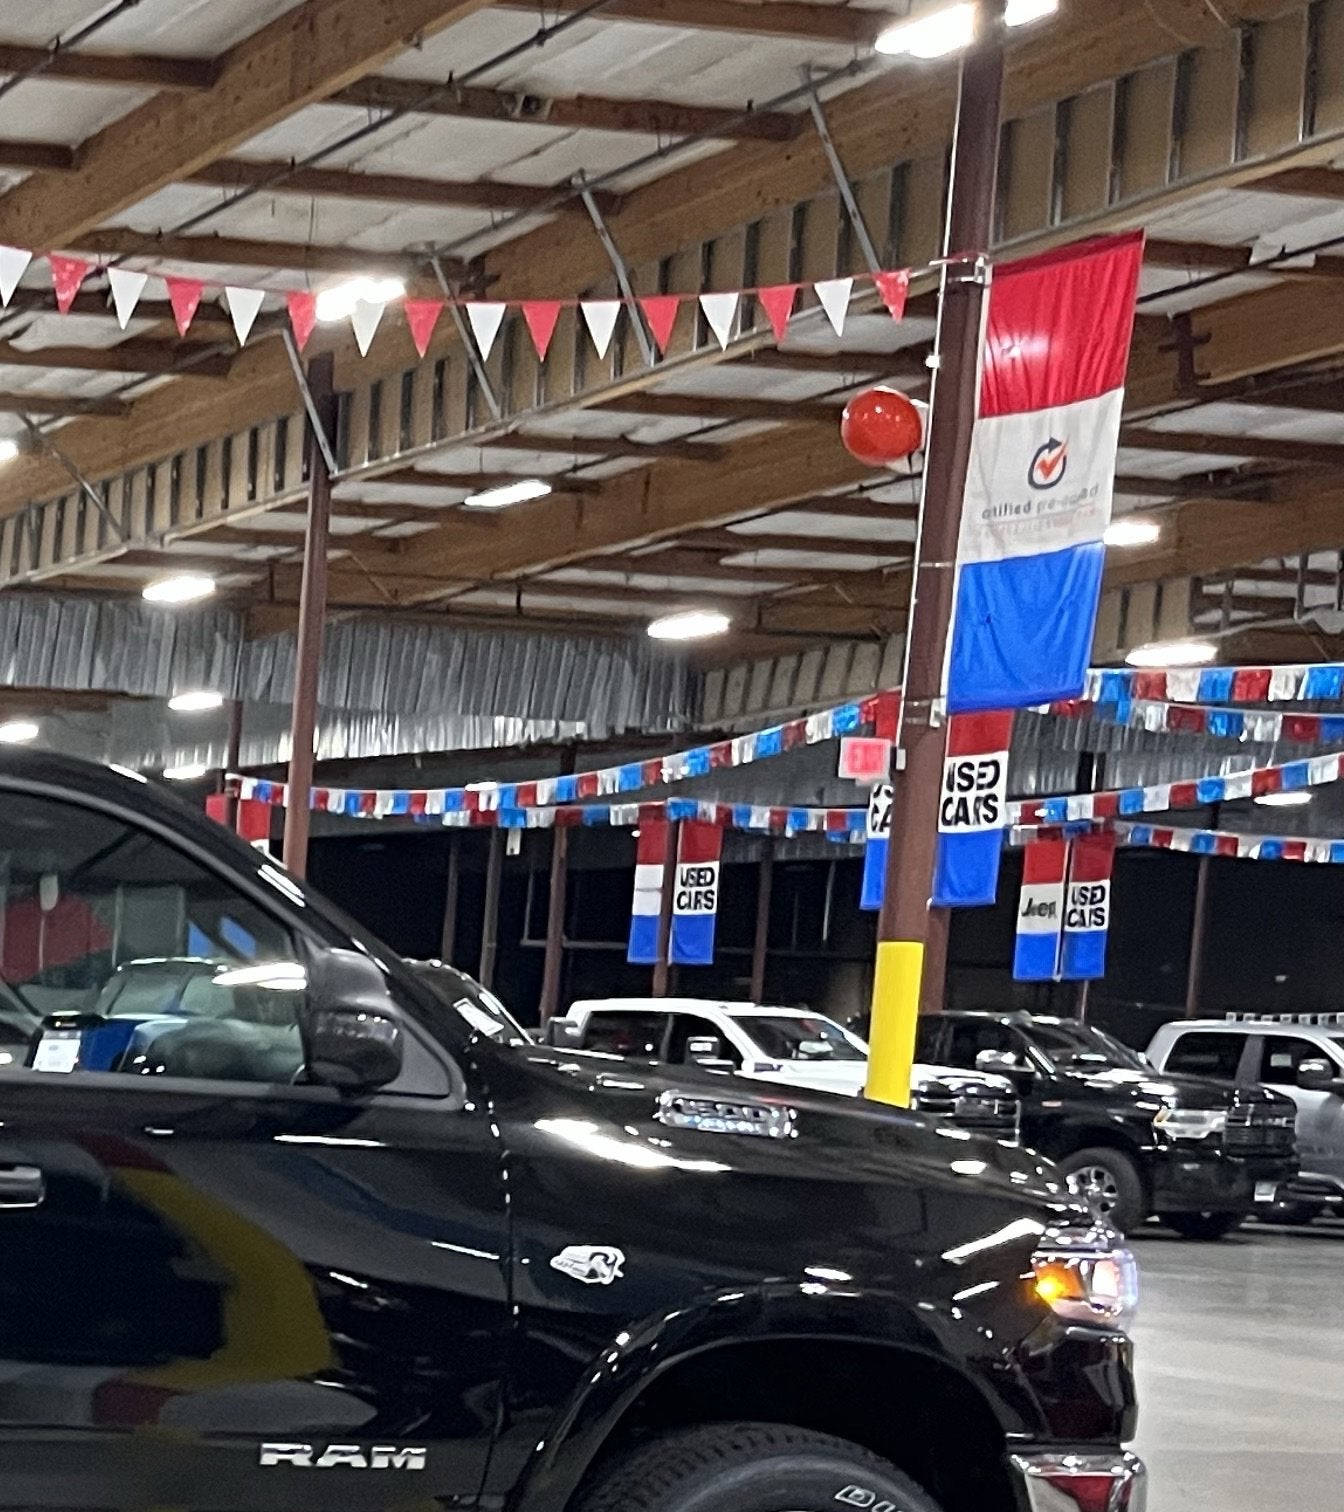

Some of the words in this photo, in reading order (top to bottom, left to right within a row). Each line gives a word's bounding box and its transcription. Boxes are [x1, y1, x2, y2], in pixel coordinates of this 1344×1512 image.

[946, 759, 1001, 793] USED
[941, 793, 999, 826] CARS
[680, 866, 716, 888] USED
[676, 888, 715, 911] CARS
[1071, 884, 1106, 906] USED
[259, 1442, 428, 1471] RAM
